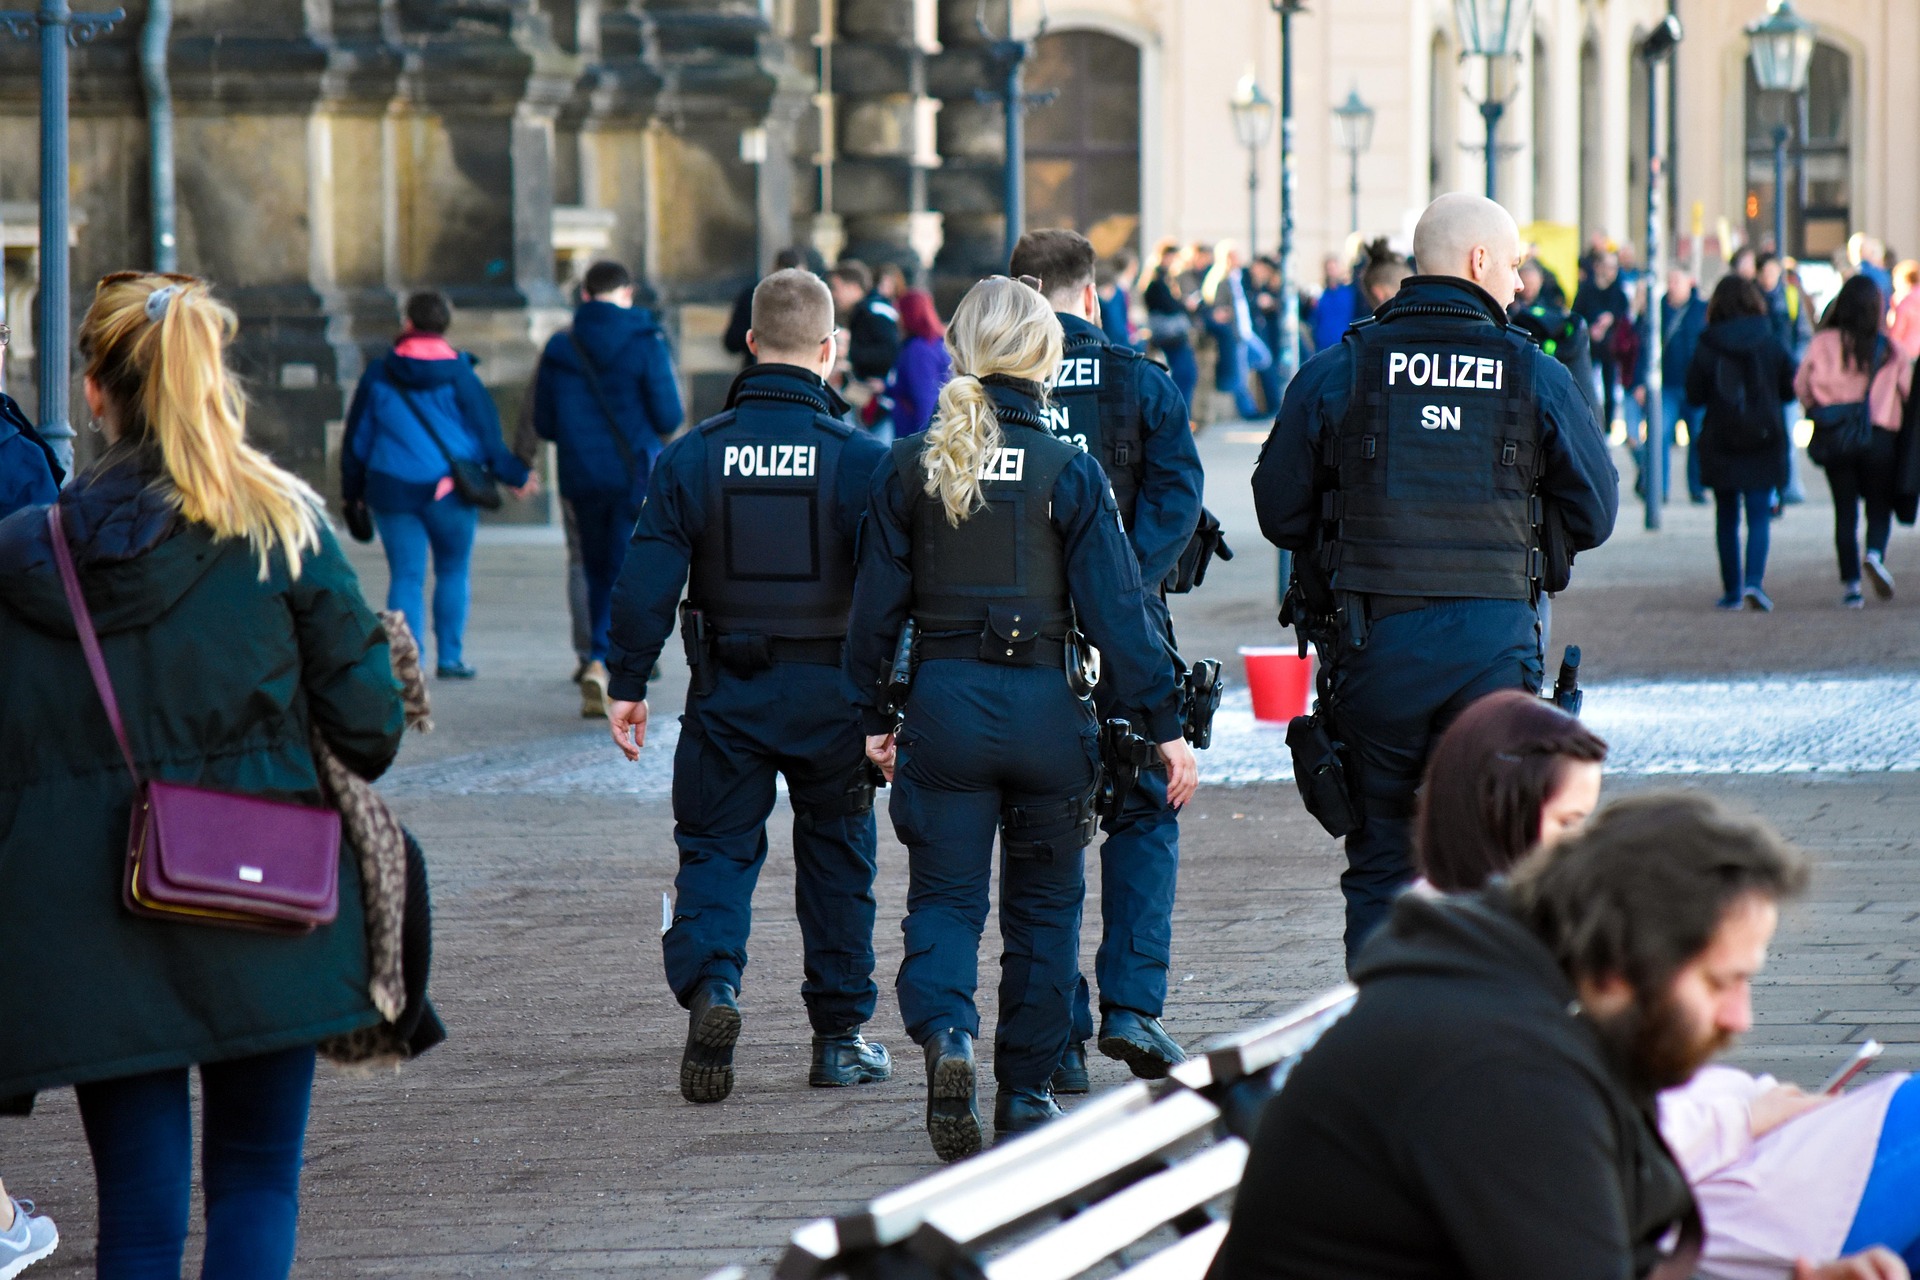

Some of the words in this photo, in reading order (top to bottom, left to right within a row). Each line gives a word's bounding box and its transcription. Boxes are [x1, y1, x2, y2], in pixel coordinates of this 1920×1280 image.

[1388, 352, 1503, 390] POLIZEI
[1421, 405, 1461, 430] SN
[723, 445, 816, 477] POLIZEI
